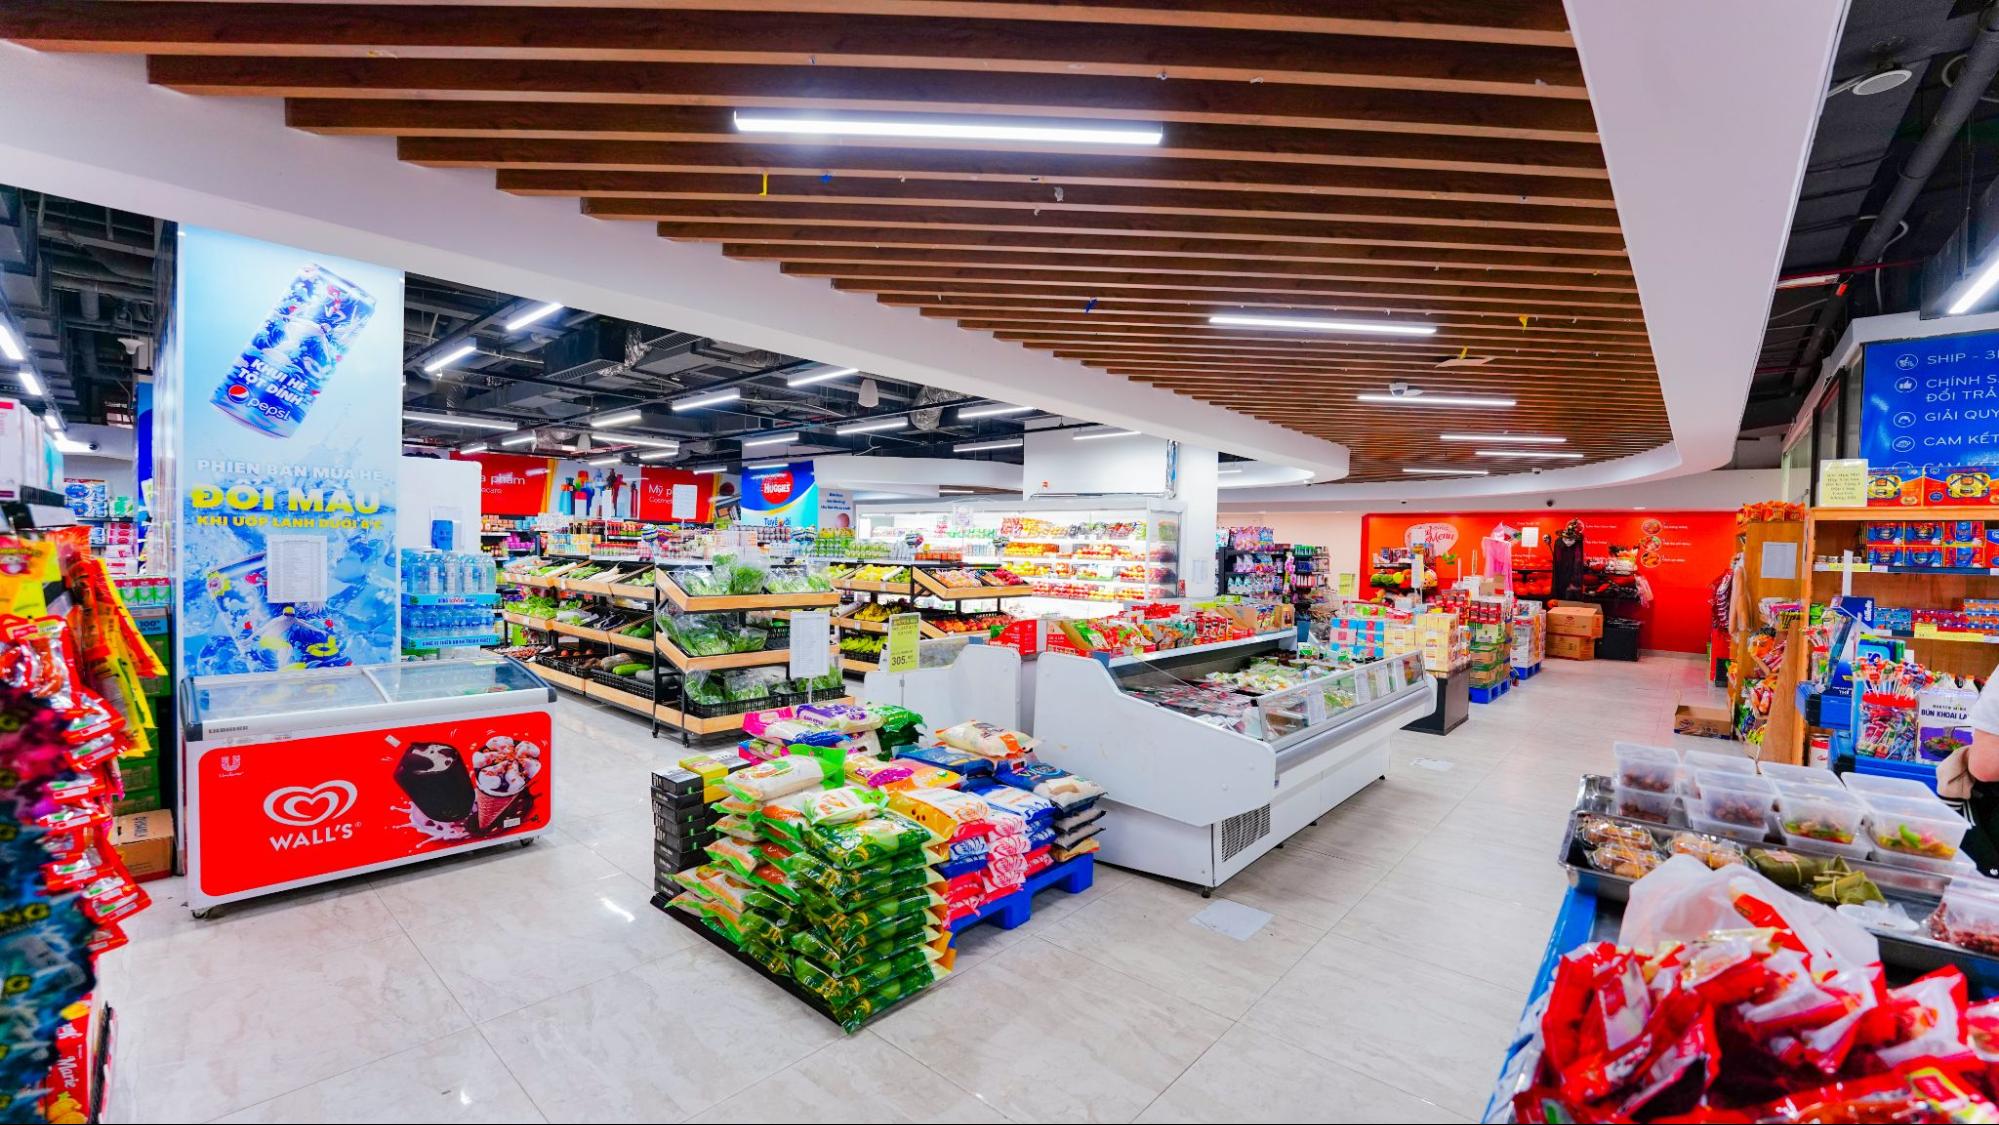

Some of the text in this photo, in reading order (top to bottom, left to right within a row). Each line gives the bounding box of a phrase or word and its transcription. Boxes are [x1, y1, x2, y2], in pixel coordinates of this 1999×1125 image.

[1927, 352, 1966, 365] SHIP
[1985, 349, 1999, 360] 3
[250, 358, 289, 384] KHUI
[1926, 374, 1999, 388] CHÍNH S
[1961, 386, 1997, 400] TRẢ
[246, 398, 291, 420] pepsi
[1924, 408, 1958, 422] GIẢI
[1923, 431, 1999, 446] CAM KẾT
[1936, 710, 1957, 720] KHOAI
[269, 823, 353, 852] WALL'S
[56, 1055, 79, 1089] Marie
